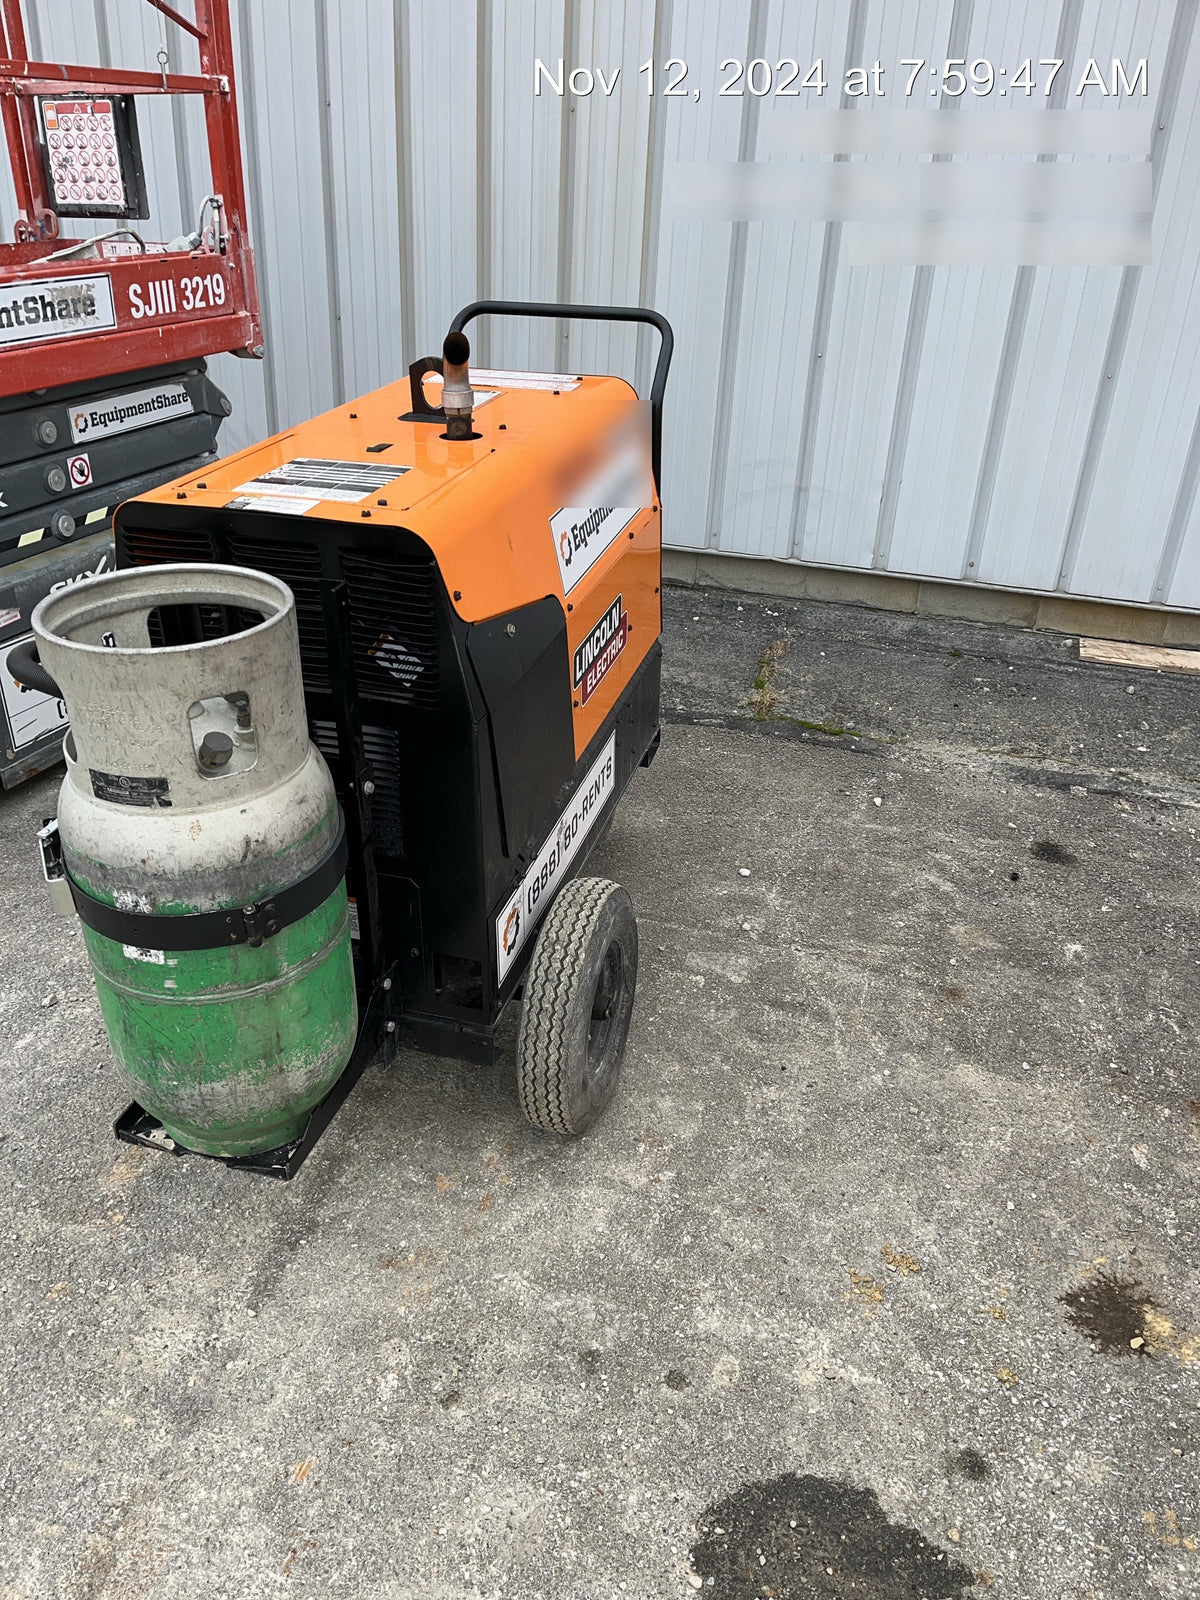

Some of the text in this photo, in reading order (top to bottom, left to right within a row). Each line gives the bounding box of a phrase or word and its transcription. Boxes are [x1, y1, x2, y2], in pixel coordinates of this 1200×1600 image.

[128, 273, 225, 319] SJIII 3219
[89, 390, 189, 429] EquipmentShare
[575, 602, 620, 682] LINCOLN
[587, 629, 623, 694] ELECTRIC
[564, 756, 613, 851] 80-RENTS
